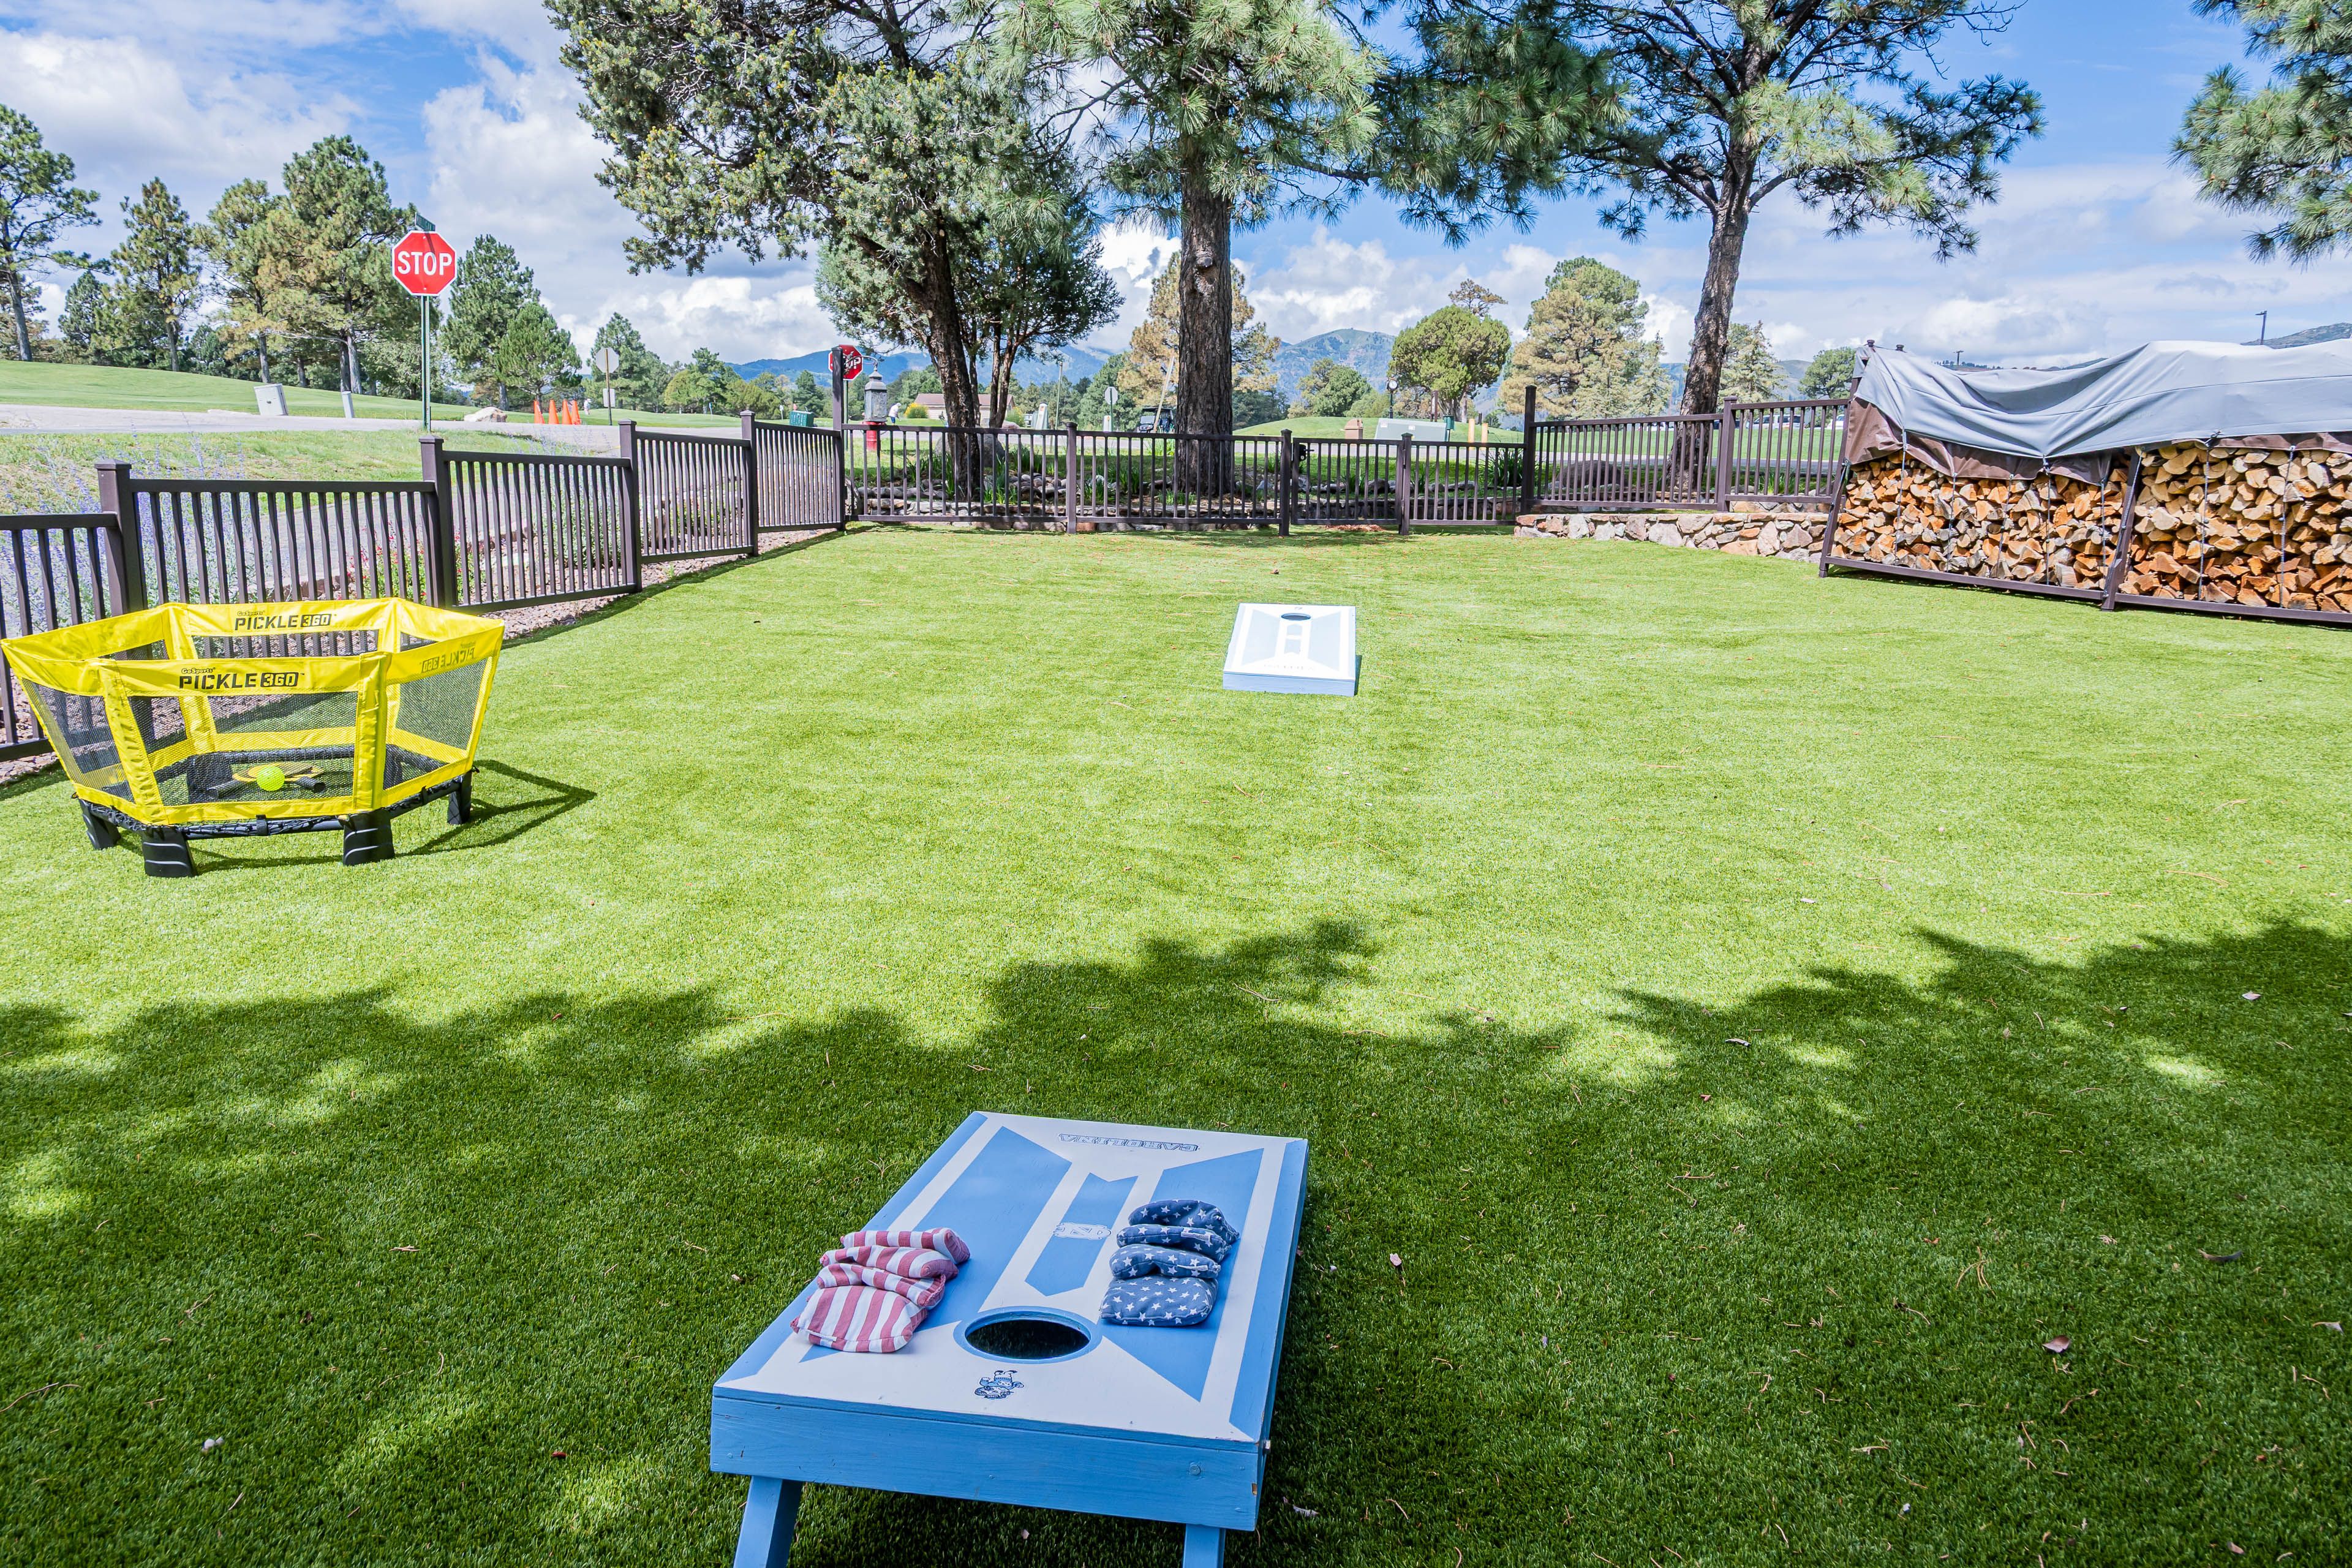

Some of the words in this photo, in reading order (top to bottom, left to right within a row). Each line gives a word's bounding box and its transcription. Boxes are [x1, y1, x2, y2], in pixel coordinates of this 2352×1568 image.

[398, 251, 452, 276] STOP
[235, 615, 298, 630] PICKLE
[301, 614, 331, 627] 360
[179, 673, 257, 690] PICKLE
[260, 672, 299, 687] 360
[1059, 1133, 1199, 1152] CAROLINA
